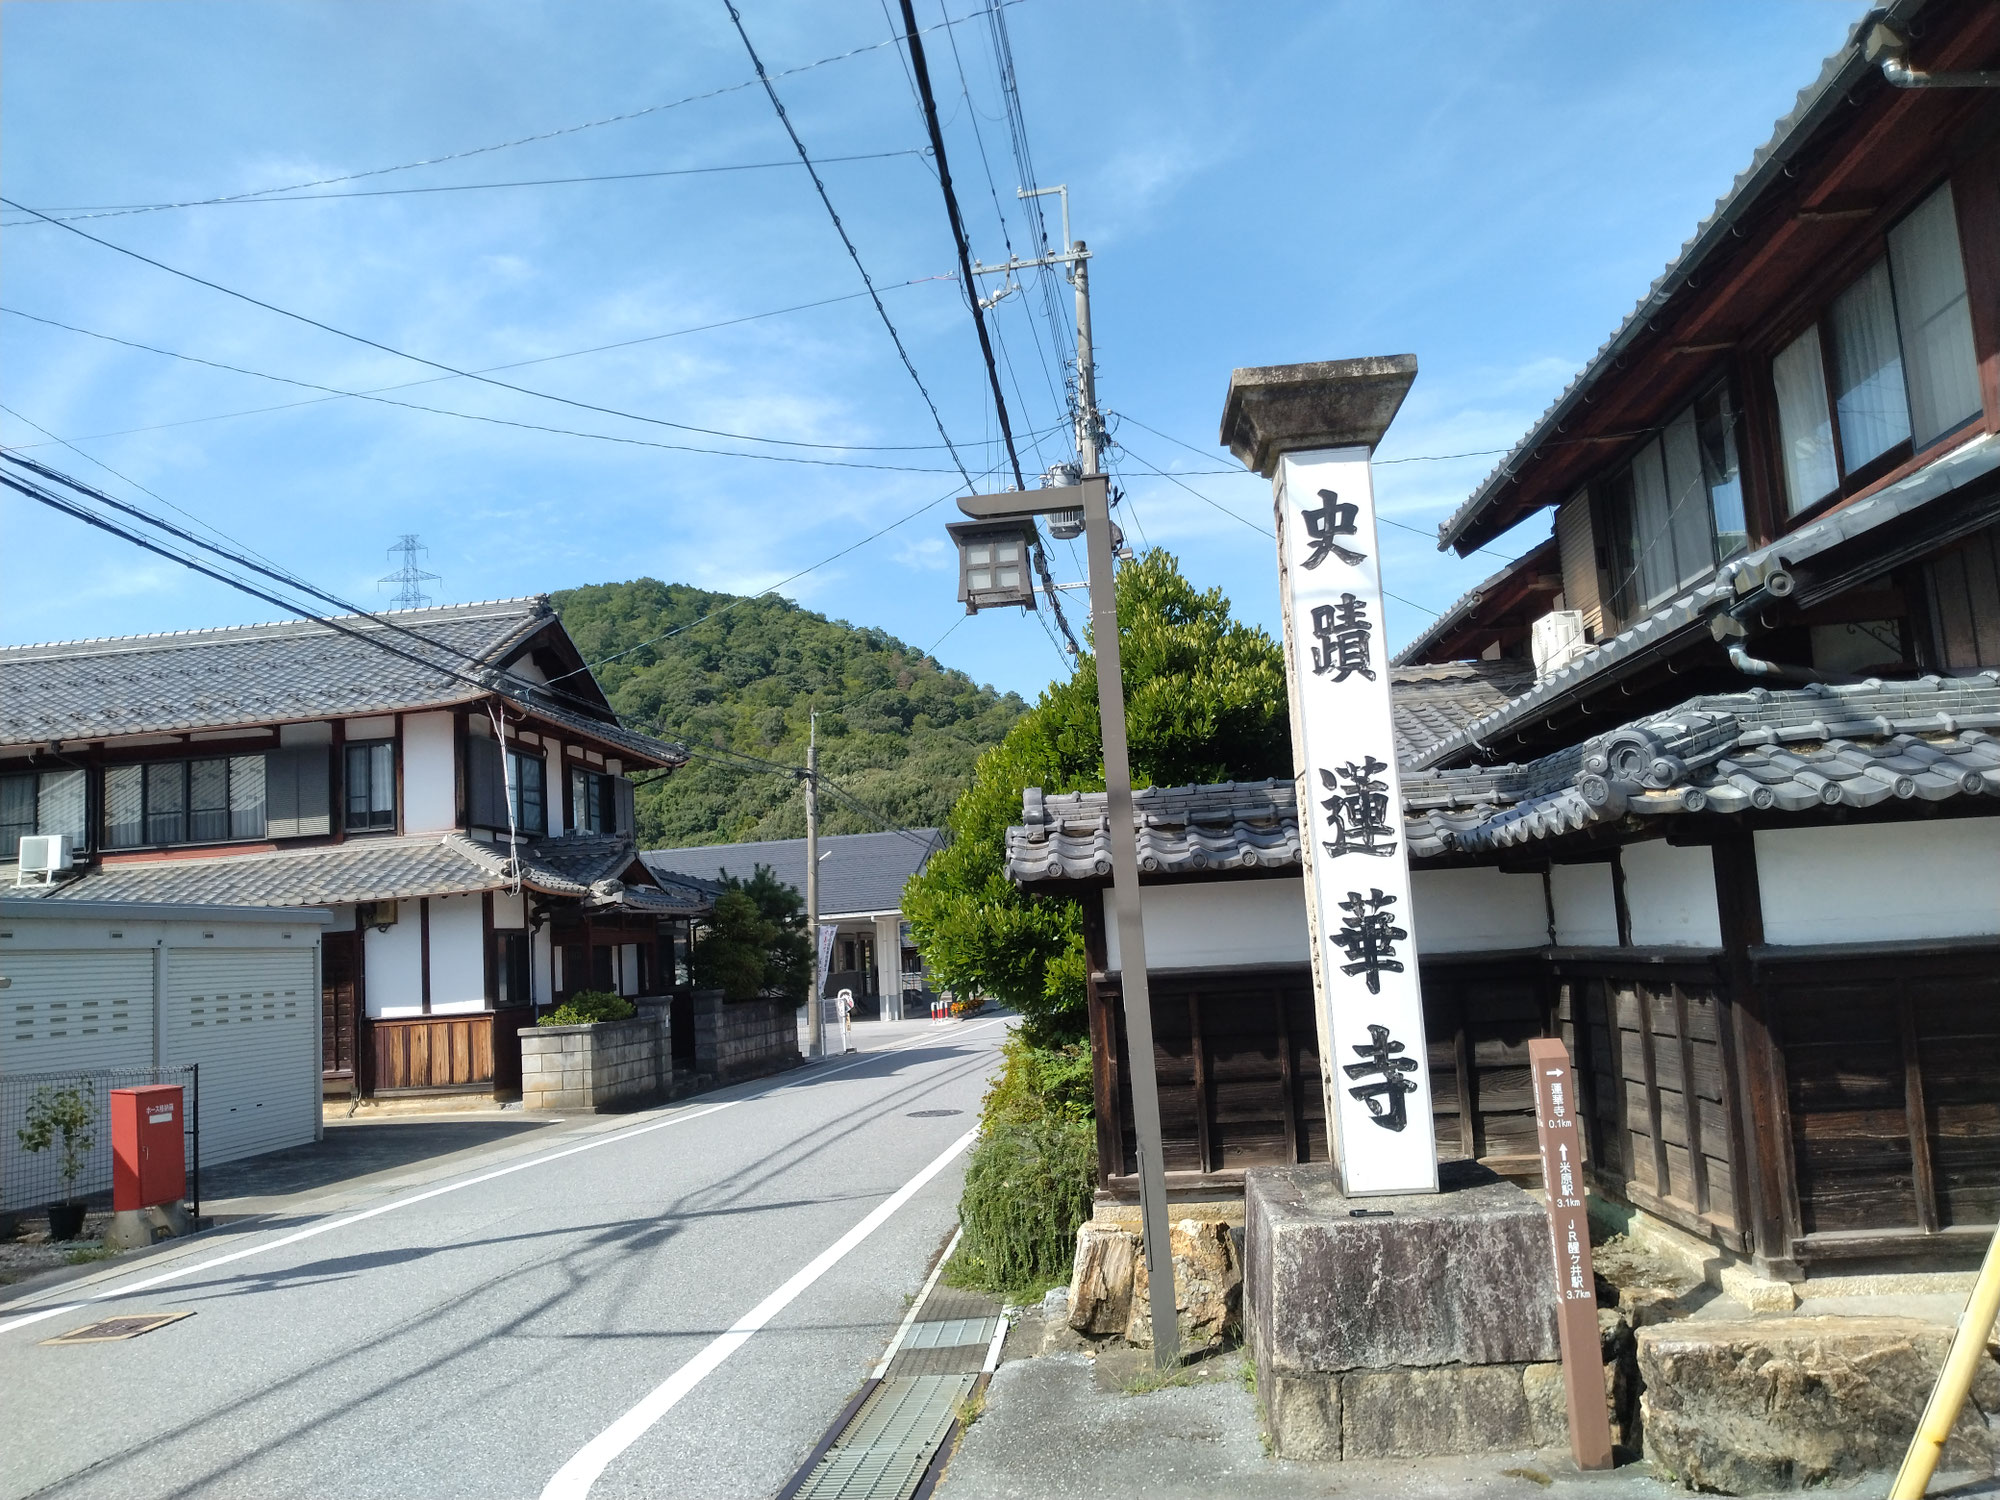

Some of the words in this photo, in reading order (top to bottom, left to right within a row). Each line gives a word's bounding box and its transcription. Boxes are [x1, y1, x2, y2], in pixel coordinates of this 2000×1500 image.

[1300, 489, 1376, 683] 史蹟
[1319, 756, 1418, 1132] 蓮華寺
[1551, 1082, 1565, 1117] 蓮華寺
[1548, 1119, 1572, 1129] 0.1km
[1560, 1161, 1574, 1196] 米原駅
[1557, 1198, 1581, 1208] 3.1km
[1566, 1290, 1591, 1300] 3.7km
